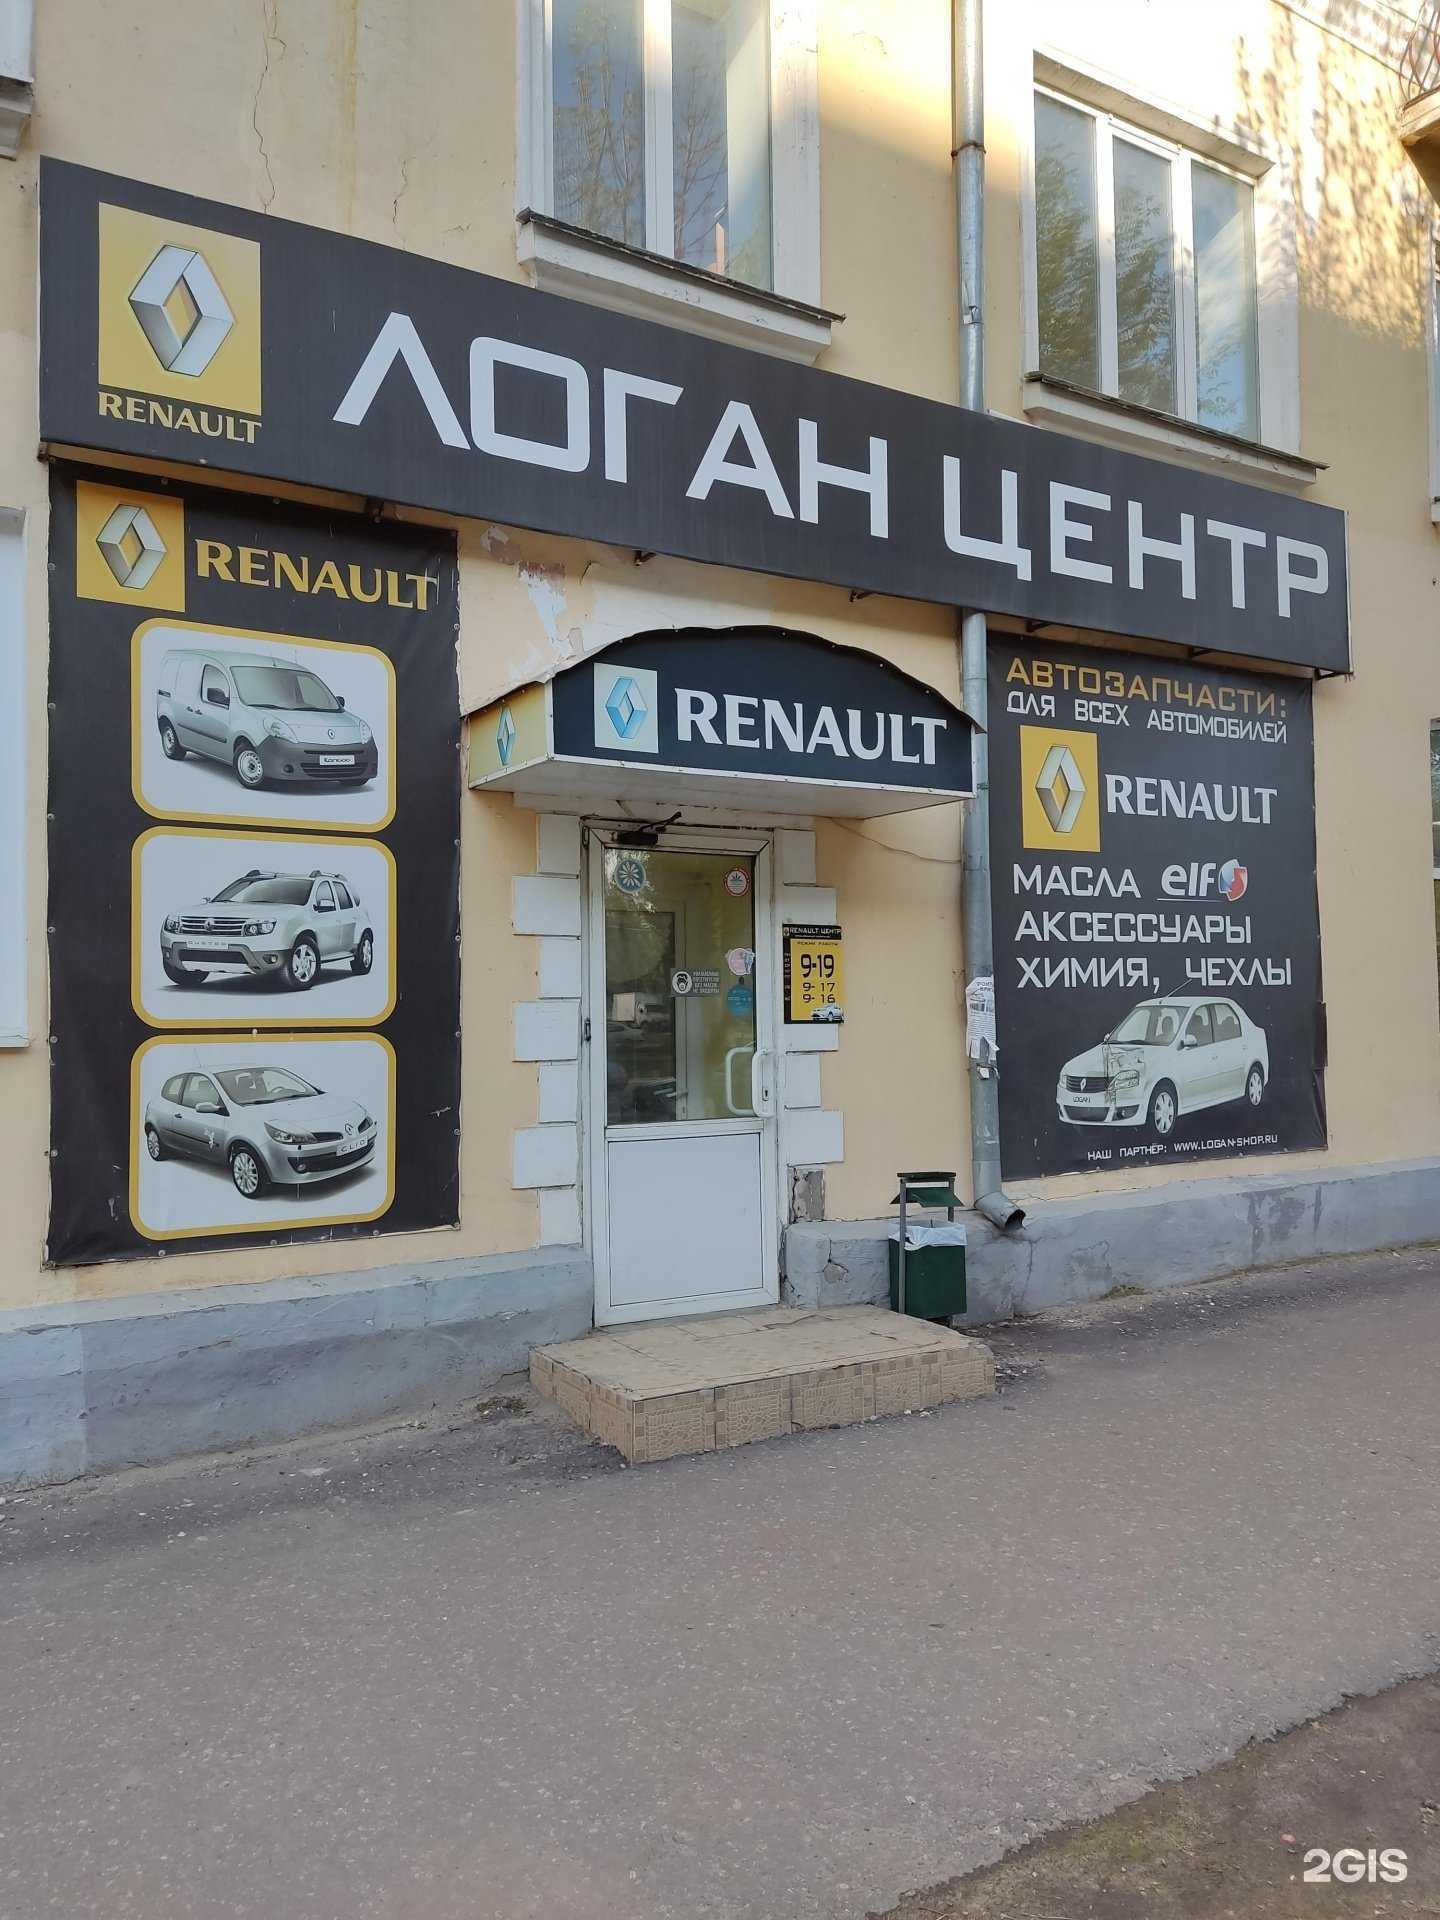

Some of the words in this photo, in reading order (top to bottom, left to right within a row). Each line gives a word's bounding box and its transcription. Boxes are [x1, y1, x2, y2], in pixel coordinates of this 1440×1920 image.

[98, 390, 262, 445] RENAULT
[332, 311, 889, 540] ЛОГАН
[942, 454, 1330, 619] ЦЕНТР
[194, 538, 438, 611] RENAULT
[1005, 656, 1287, 719] АВТОЗАПЧАСТИ:
[673, 687, 948, 765] RENAULT
[1006, 691, 1056, 718] ДЛЯ
[1074, 698, 1131, 727] ВСЕХ
[1146, 708, 1288, 744] АВТОМОБИЛЕЙ
[1104, 773, 1278, 825] RENAULT
[1013, 863, 1142, 899] МАСЛА
[1160, 862, 1217, 898] elf
[1013, 910, 1252, 944] АКСЕССУАРЫ
[801, 953, 834, 978] 9-19
[1016, 957, 1160, 994] ХИМИЯ,
[1185, 957, 1292, 986] ЧЕХЛЫ
[1087, 1149, 1112, 1161] НАШ
[1173, 1134, 1278, 1153] WWW.LOGAN-SHOP.RU
